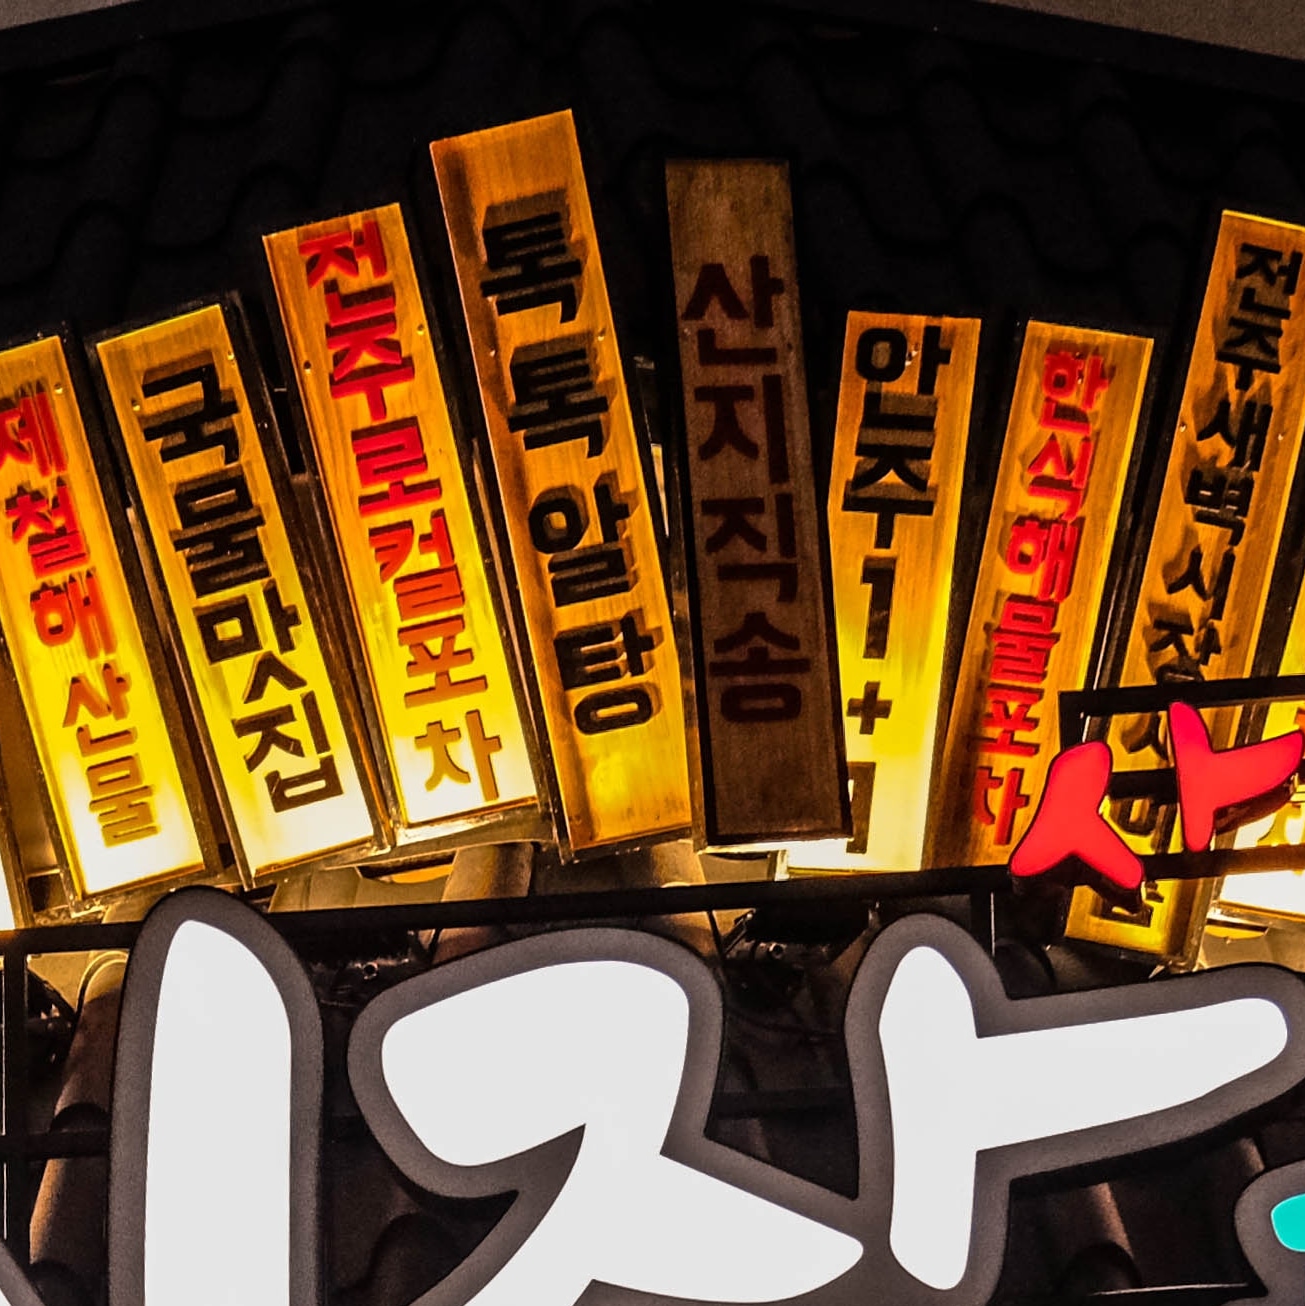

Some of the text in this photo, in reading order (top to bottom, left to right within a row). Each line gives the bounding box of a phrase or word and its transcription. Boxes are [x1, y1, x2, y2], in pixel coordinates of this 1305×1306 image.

[142, 352, 346, 814] 국물맛집
[296, 220, 506, 802] 전주로컬포차
[480, 196, 660, 736] 톡톡알탕
[682, 254, 812, 724] 산지직송
